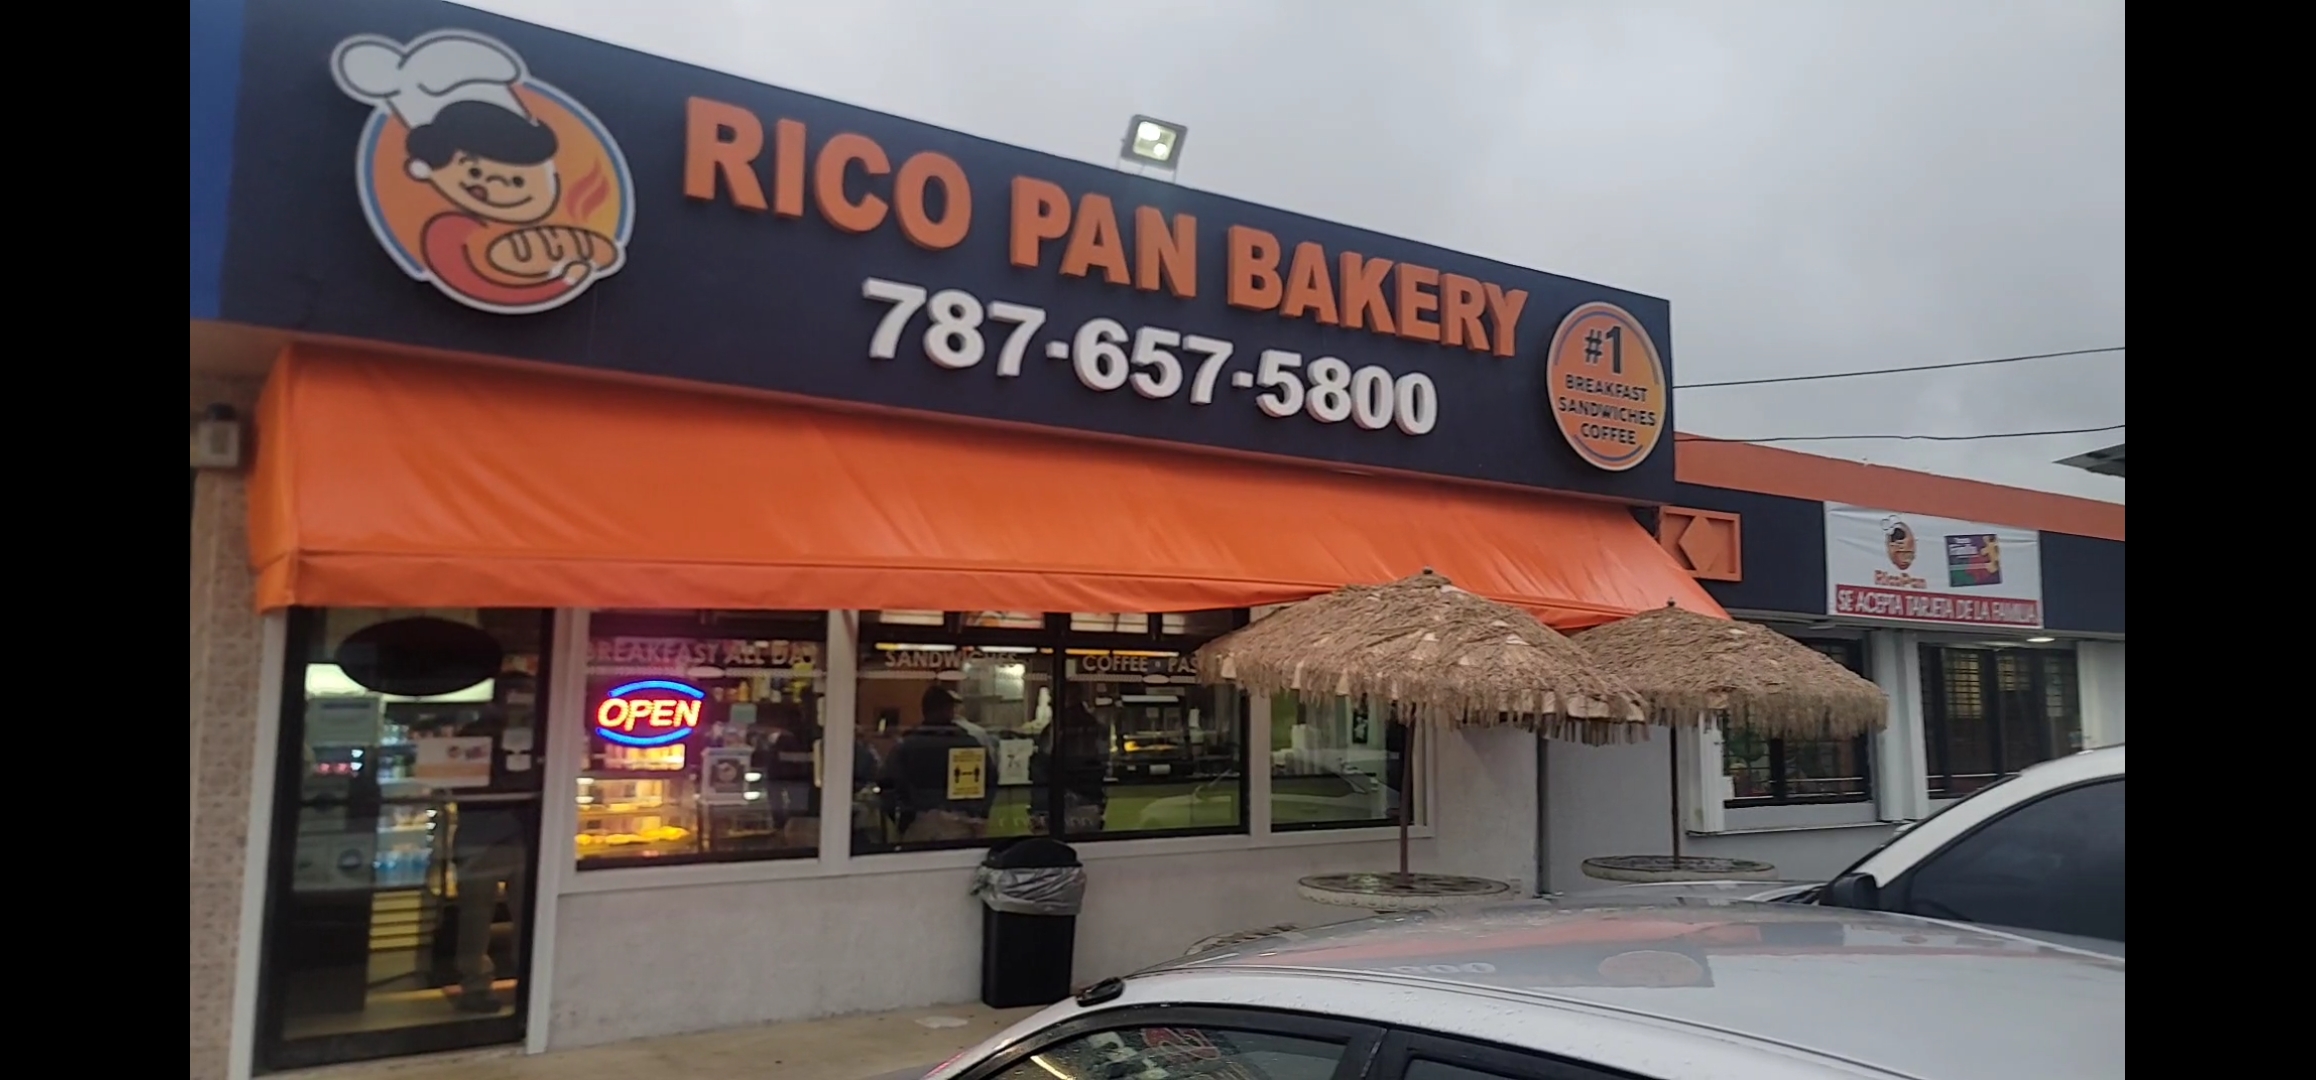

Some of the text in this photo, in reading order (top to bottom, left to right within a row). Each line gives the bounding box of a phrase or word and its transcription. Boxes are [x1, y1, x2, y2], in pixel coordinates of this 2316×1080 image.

[684, 96, 1529, 357] RICO PAN BAKERY
[862, 277, 1438, 436] 787-657-5800
[1584, 325, 1622, 374] #1
[1565, 374, 1648, 402] BREAKFAST
[1558, 396, 1656, 427] SANDWICHES
[1580, 422, 1637, 445] COFFEE
[1838, 589, 1854, 612] SE
[1855, 590, 1904, 615] ACEPTA
[1905, 595, 1955, 619] TARJETA
[1957, 599, 1973, 620] DE
[1974, 600, 1989, 622] LA
[586, 637, 720, 665] BREAKFAST
[722, 639, 766, 665] ALL
[884, 650, 1020, 669] SANDWICHES
[1082, 655, 1197, 674] COFFEE PAS
[598, 697, 702, 732] OPEN
